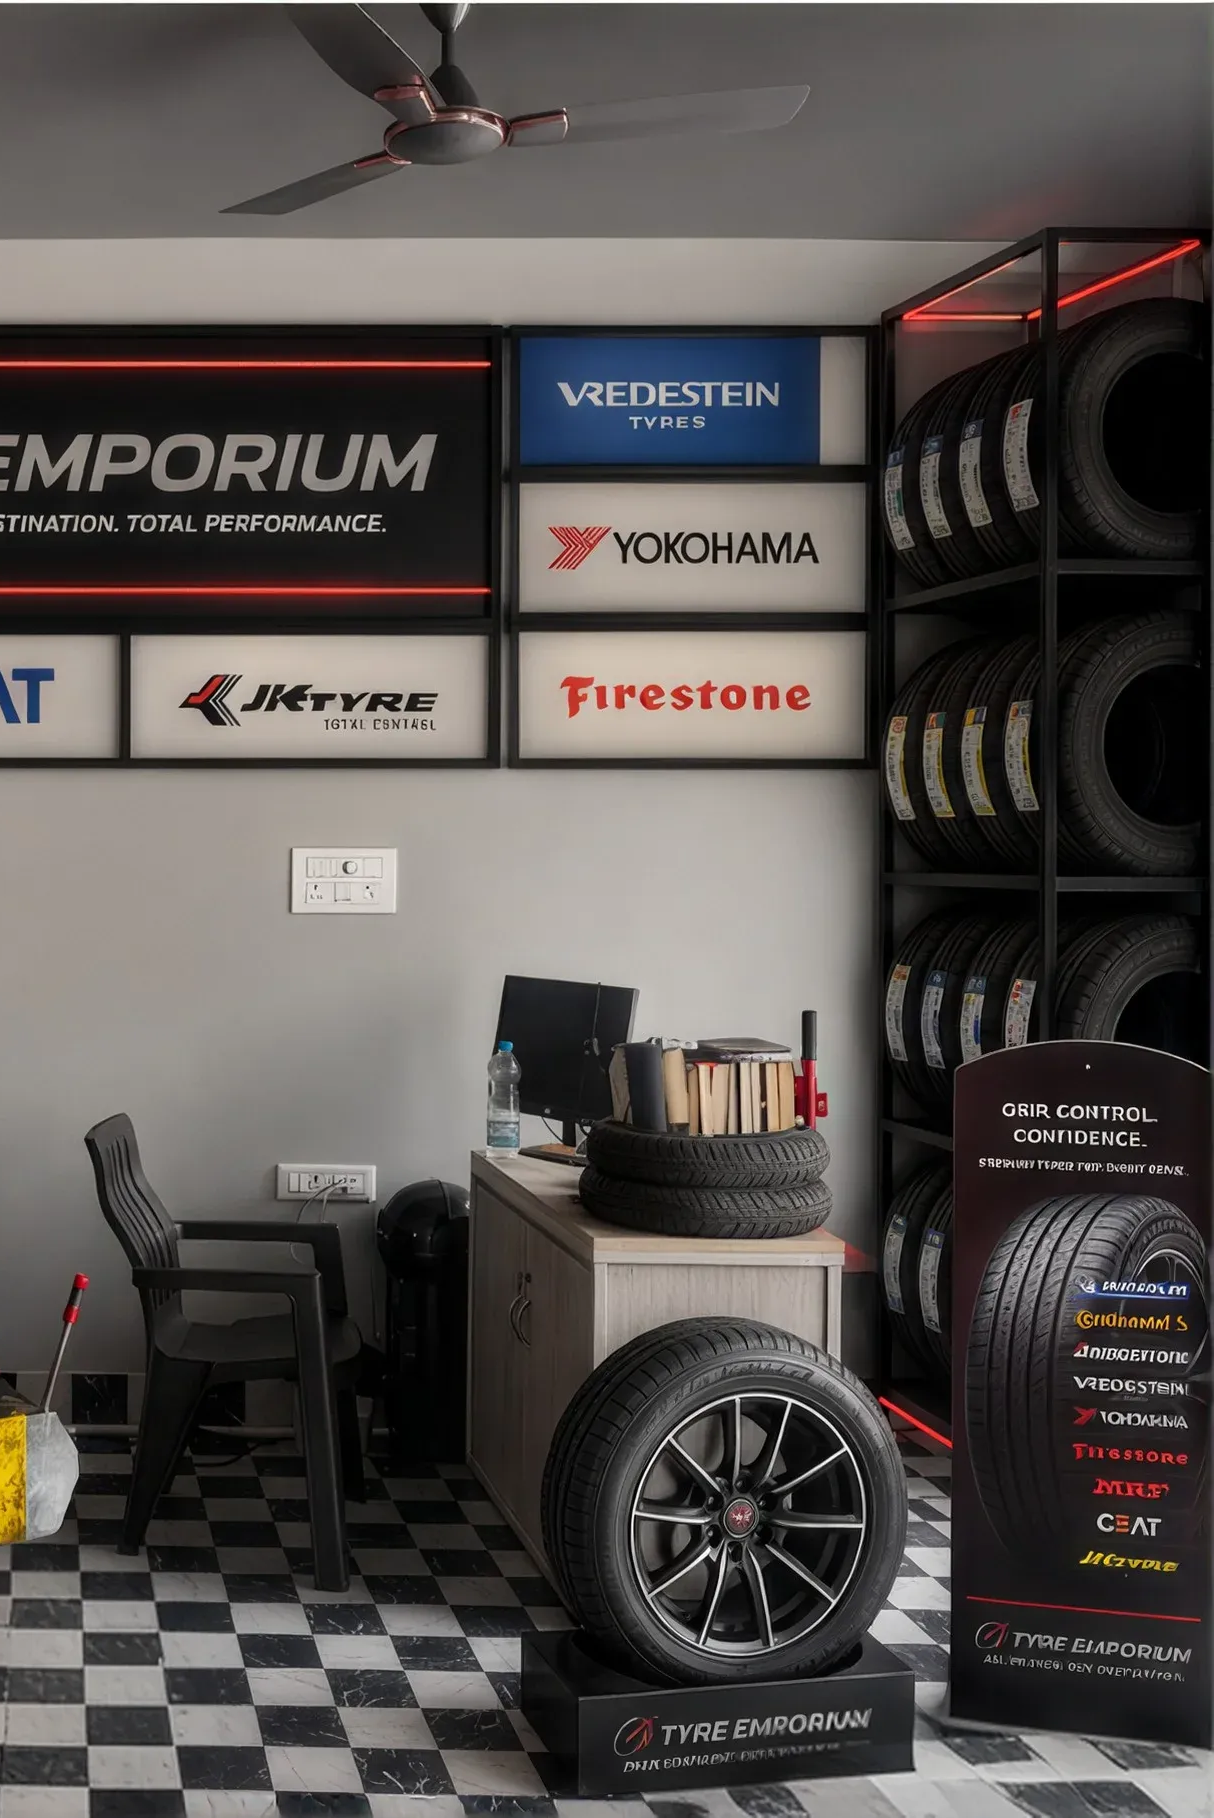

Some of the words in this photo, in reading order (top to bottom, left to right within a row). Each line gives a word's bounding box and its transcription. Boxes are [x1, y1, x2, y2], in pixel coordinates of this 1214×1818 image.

[557, 381, 780, 407] VREDESTEIN
[629, 416, 706, 430] TYRES
[127, 514, 198, 532] TOTAL
[204, 514, 387, 533] PERFORMANCE.
[613, 532, 819, 564] YOKOHAMA
[560, 676, 811, 719] Firestone
[1096, 1513, 1162, 1537] CEAT
[1012, 1631, 1068, 1651] TYRE
[661, 1719, 729, 1746] TYRE
